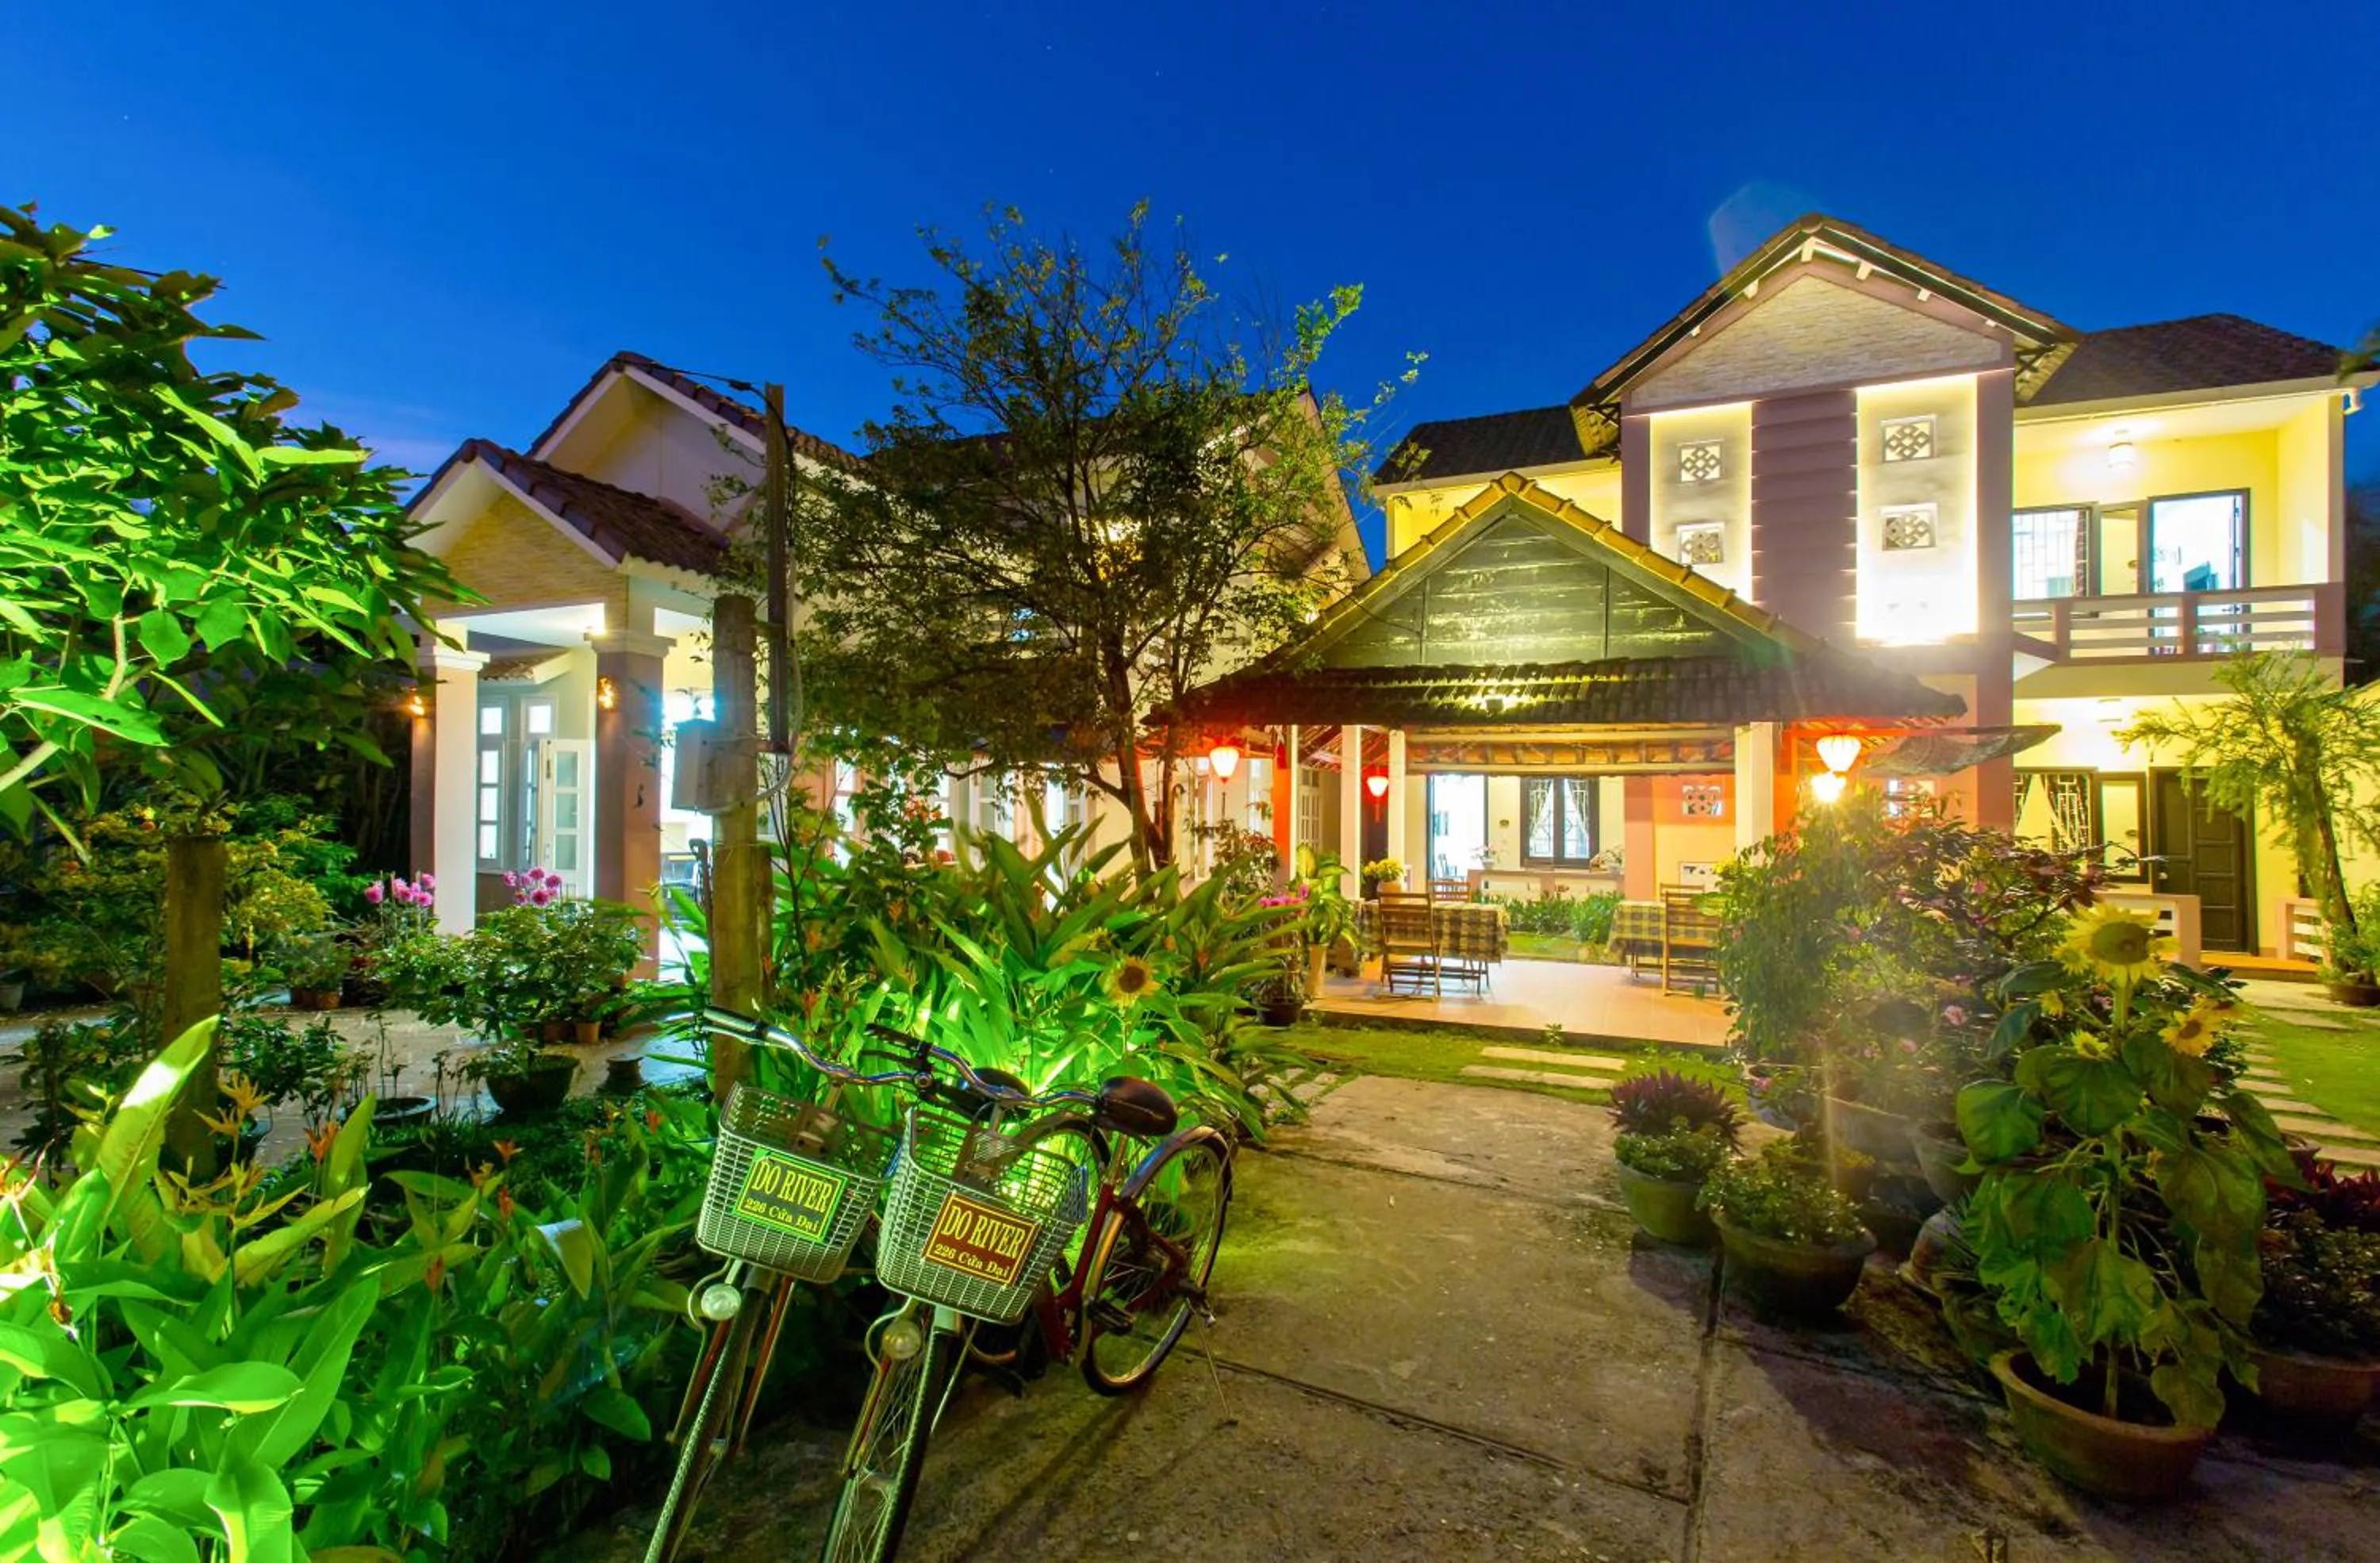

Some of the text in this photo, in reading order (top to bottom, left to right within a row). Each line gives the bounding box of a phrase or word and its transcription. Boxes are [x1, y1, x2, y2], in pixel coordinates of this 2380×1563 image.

[752, 1160, 832, 1213] DO RIVER
[941, 1205, 1026, 1259] DO RIVER
